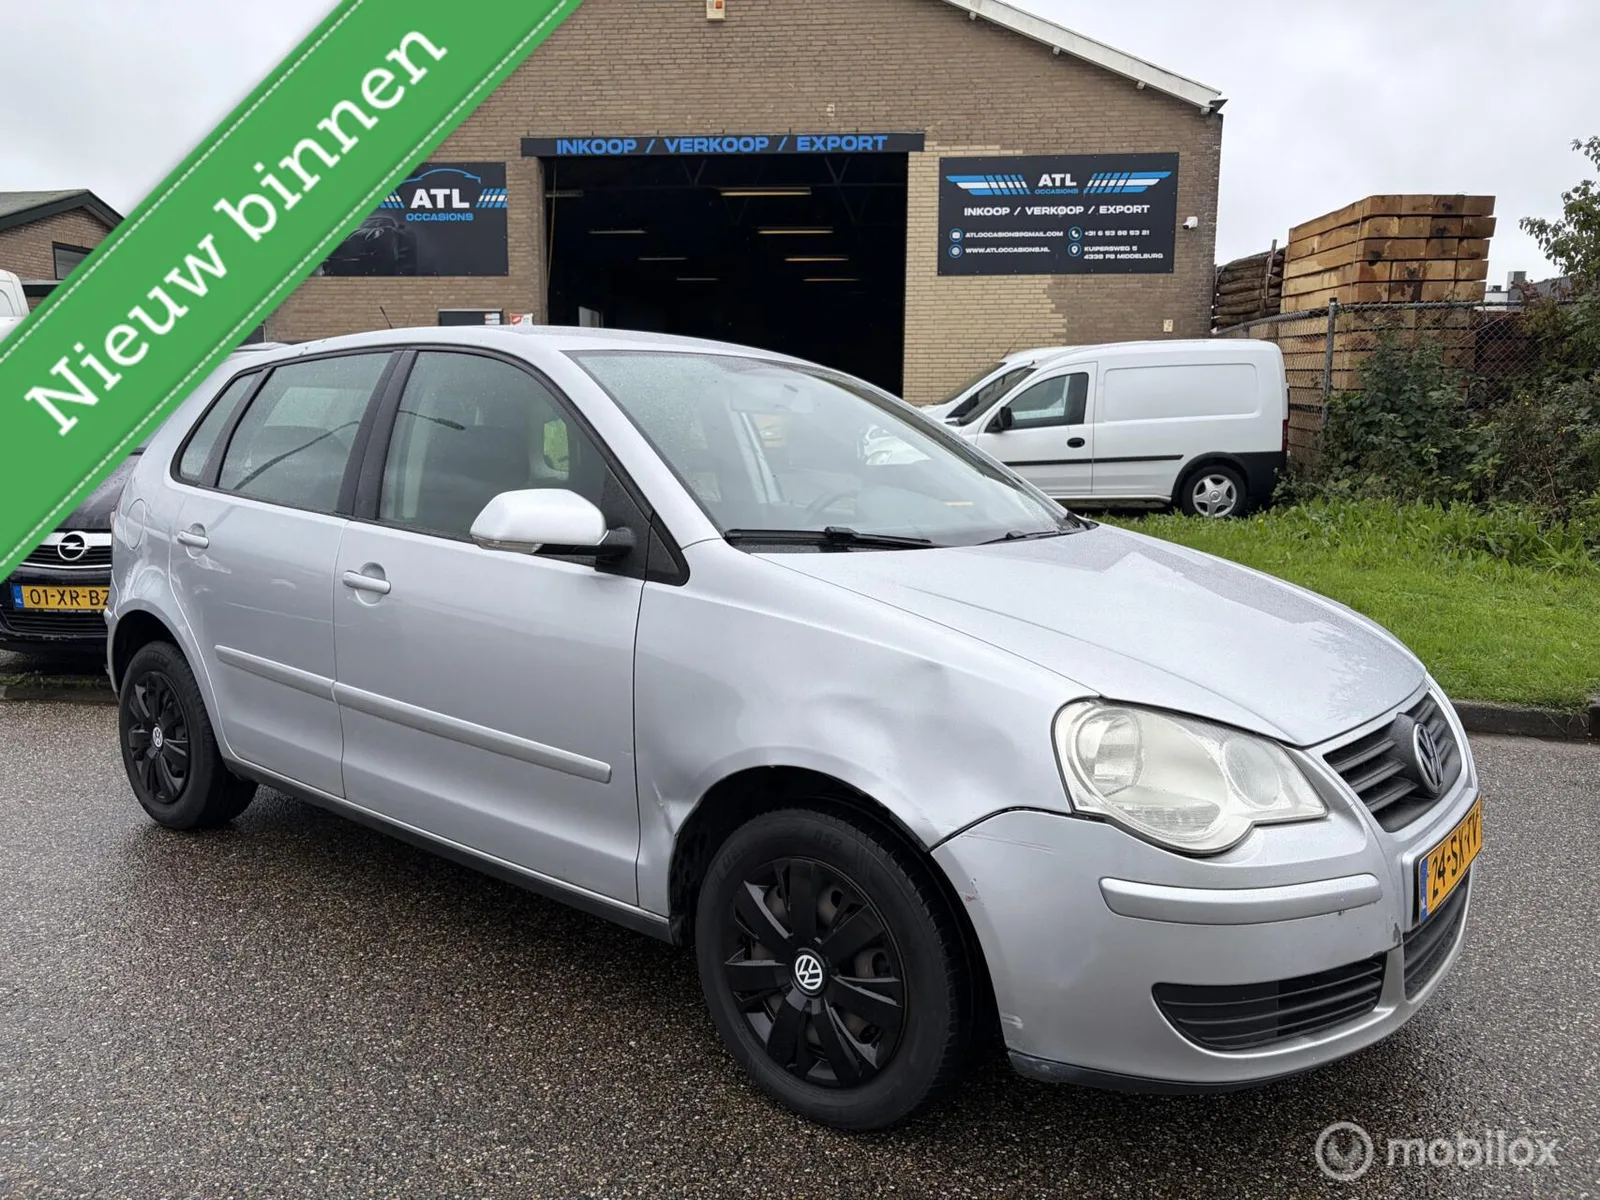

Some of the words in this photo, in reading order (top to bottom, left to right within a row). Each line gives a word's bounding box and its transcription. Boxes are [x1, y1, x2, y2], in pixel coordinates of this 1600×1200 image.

[555, 138, 638, 155] INKOOP
[663, 136, 771, 154] VERKOOP
[795, 134, 890, 152] EXPORT
[1037, 173, 1077, 187] ATL
[1034, 187, 1079, 196] OCCASIONS
[410, 188, 470, 209] ATL
[404, 211, 475, 223] OCCASIONS
[963, 206, 1011, 217] INKOOP
[1025, 205, 1085, 216] VERKOOP
[1099, 204, 1151, 215] EXPORT
[1116, 252, 1164, 260] MIDDELBURG
